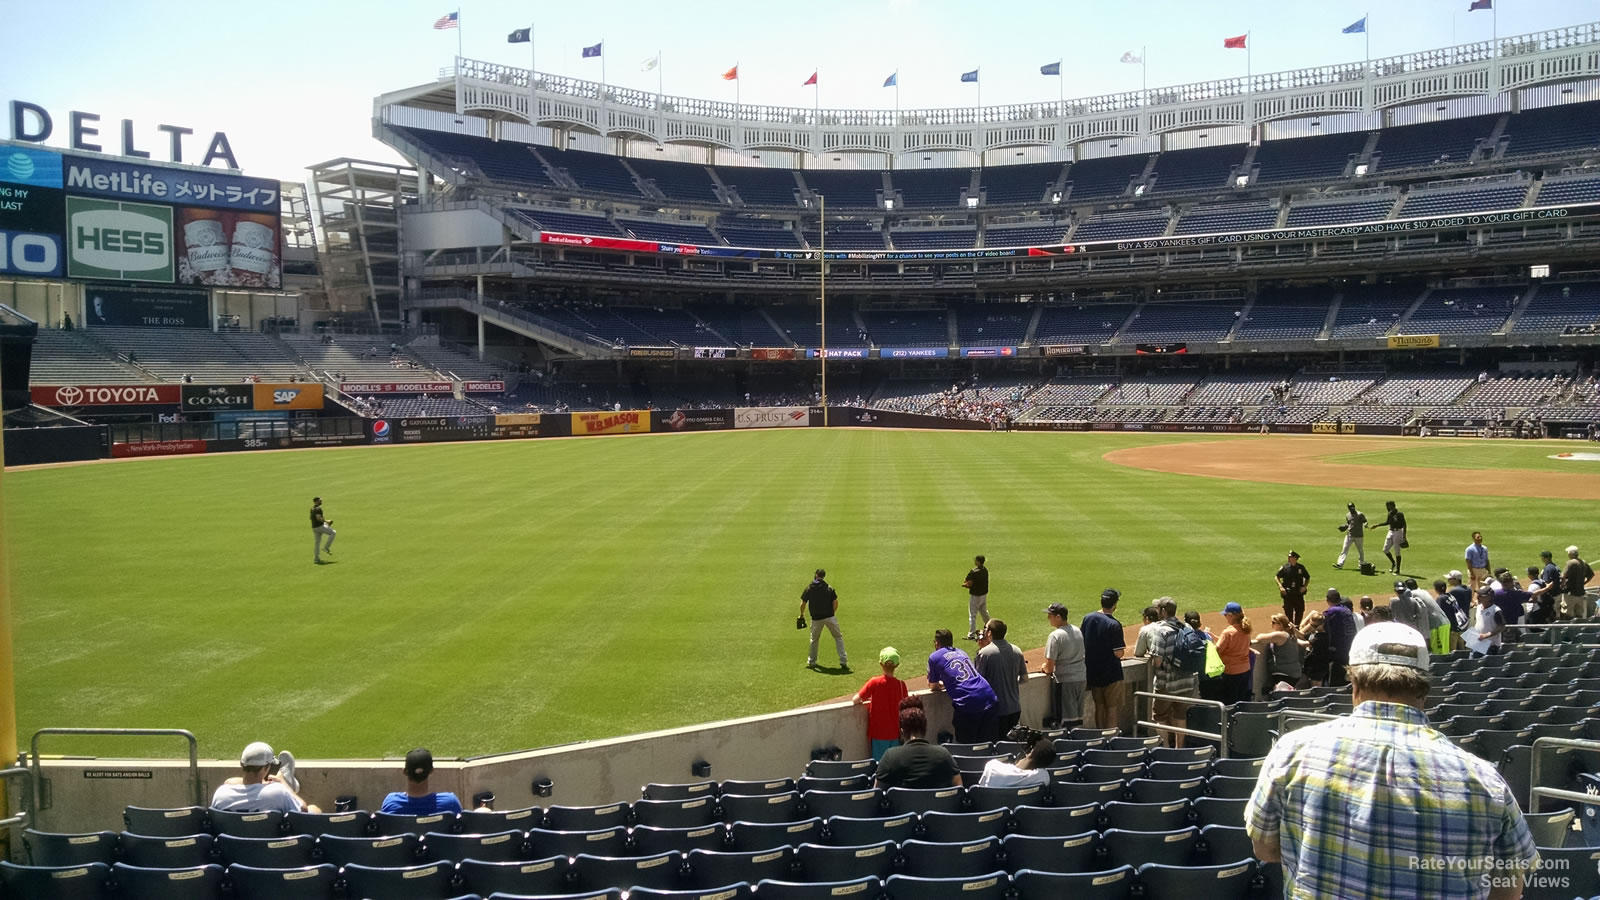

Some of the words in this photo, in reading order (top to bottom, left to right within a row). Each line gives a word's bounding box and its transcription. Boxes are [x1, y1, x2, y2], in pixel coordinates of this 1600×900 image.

[9, 100, 240, 169] DELTA
[68, 165, 168, 197] MetLife
[175, 183, 276, 206] メットライフ
[14, 189, 28, 198] MY
[1, 201, 23, 211] LAST
[1143, 241, 1157, 249] $50
[1197, 236, 1216, 245] GIFT
[1218, 235, 1241, 243] CARD
[1243, 233, 1270, 242] USING
[1272, 231, 1296, 239] YOUR
[1364, 224, 1384, 232] AND
[1386, 222, 1410, 231] HAVE
[1412, 220, 1428, 229] $10
[1430, 216, 1464, 227] ADDED
[1466, 215, 1480, 223] TO
[1482, 213, 1511, 222] YOUR
[1513, 211, 1535, 220] GIFT
[1538, 208, 1568, 218] CARD
[77, 226, 165, 255] HESS
[142, 316, 160, 325] THE
[163, 317, 185, 326] BOSS
[85, 387, 159, 403] TOYOTA
[188, 396, 248, 405] COACH
[273, 391, 297, 403] SAP
[159, 413, 188, 423] FedEx
[400, 419, 408, 427] G
[439, 418, 447, 426] G
[467, 416, 487, 425] pepsi
[738, 413, 753, 424] U.S.
[753, 412, 786, 423] TRUST
[950, 658, 979, 682] 31
